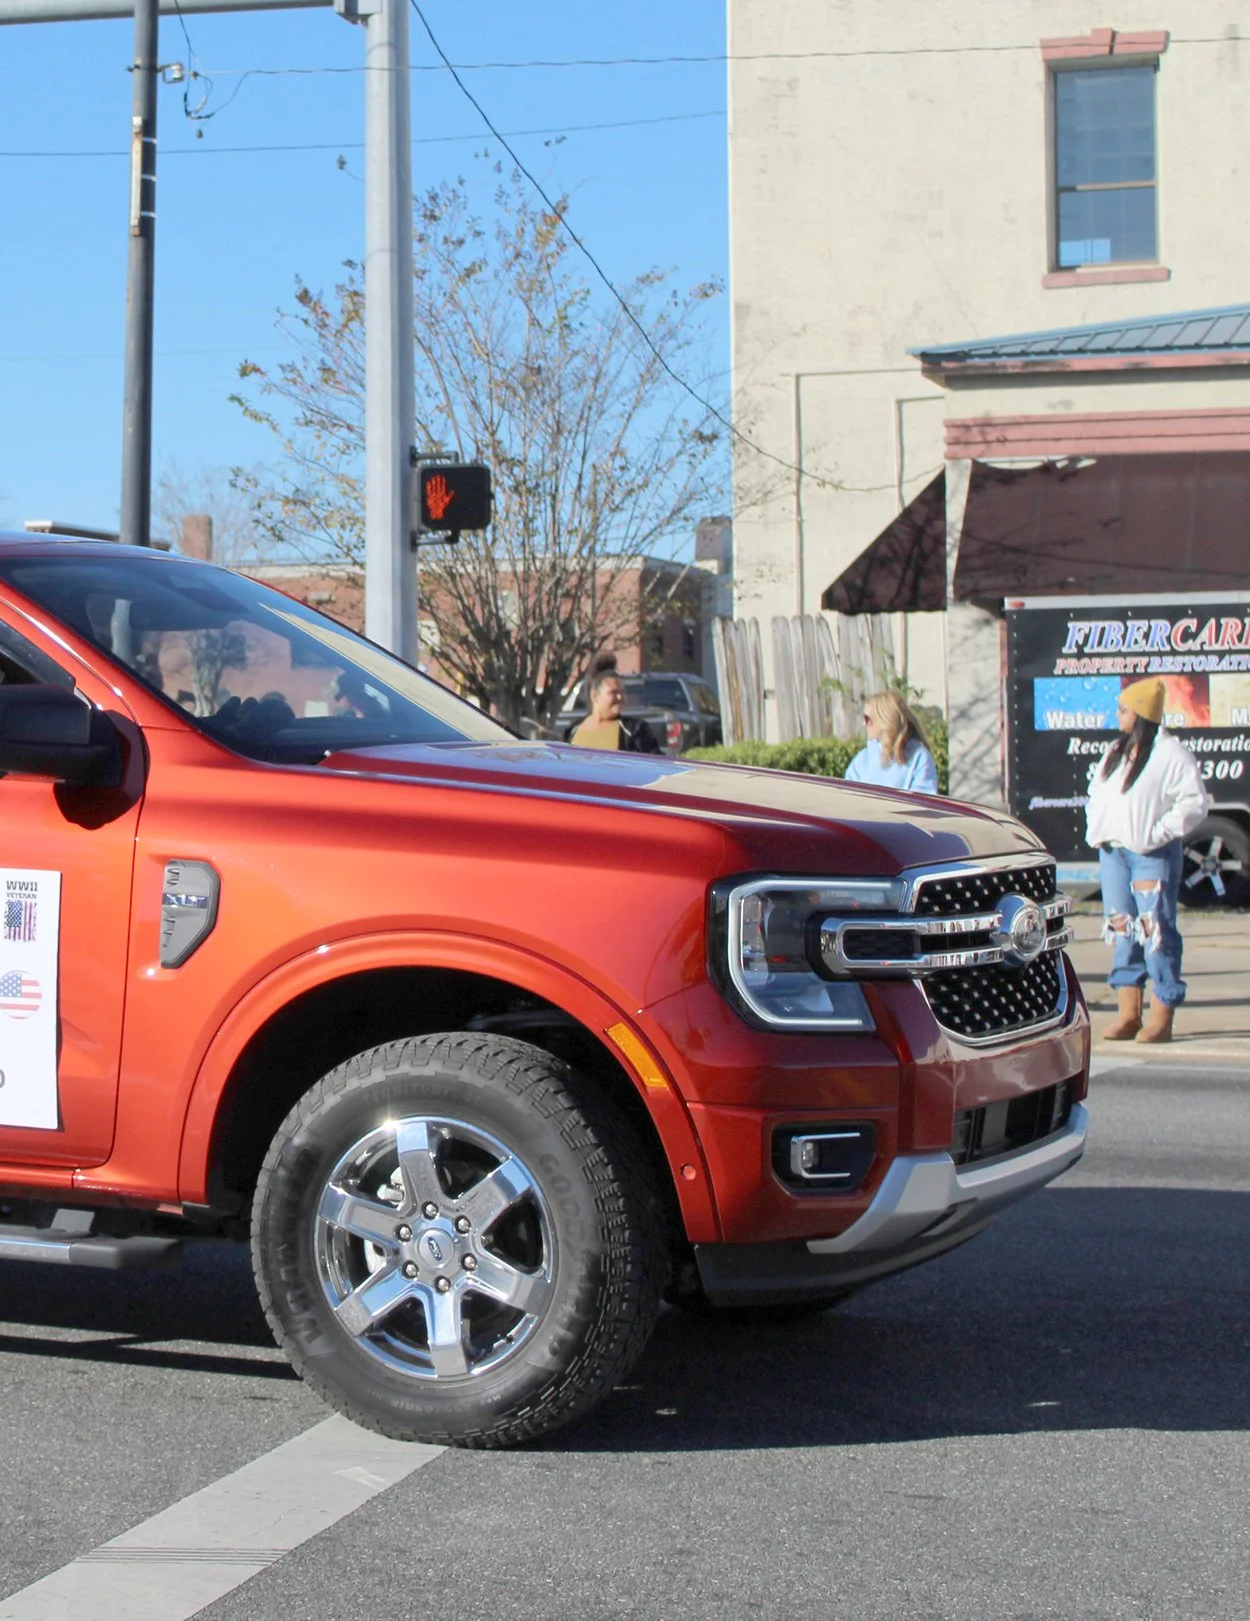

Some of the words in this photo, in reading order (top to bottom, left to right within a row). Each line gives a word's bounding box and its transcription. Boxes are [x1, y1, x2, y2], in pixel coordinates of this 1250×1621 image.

[1062, 617, 1250, 654] FIBERCAR
[1053, 657, 1149, 675] PROPERTY
[1147, 653, 1250, 673] RESTORATI
[1046, 711, 1104, 730] Water
[1066, 736, 1110, 755] Reco
[1180, 734, 1250, 752] estoratio
[6, 880, 38, 892] WWII
